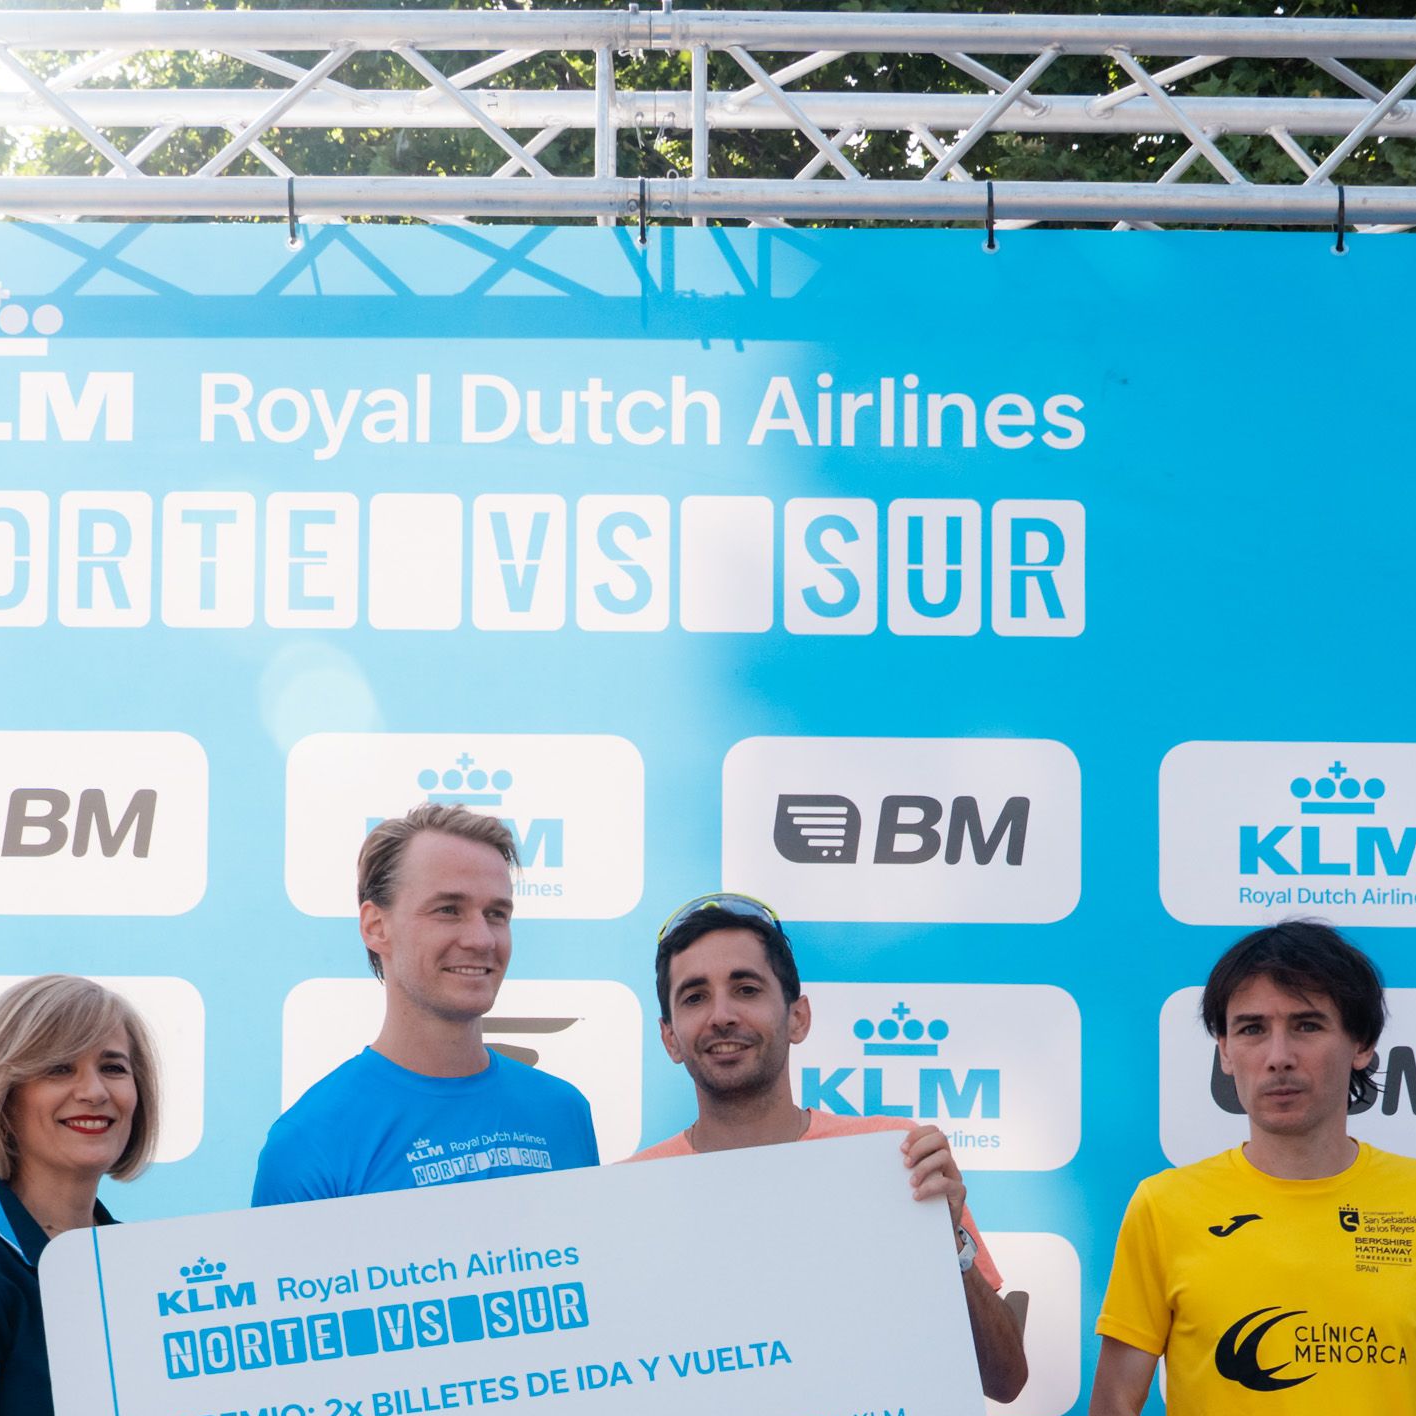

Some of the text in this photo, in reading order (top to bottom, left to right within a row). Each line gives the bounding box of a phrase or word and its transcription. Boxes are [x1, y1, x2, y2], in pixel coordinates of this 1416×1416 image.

[200, 371, 433, 460] Royal
[461, 374, 721, 447] Dutch
[748, 375, 1086, 451] Airlines
[489, 509, 656, 615] VS
[799, 512, 1066, 621] SUR
[2, 788, 157, 858] BM
[873, 795, 1030, 866] BM
[516, 880, 563, 897] lines
[1240, 888, 1291, 907] Royal
[1298, 888, 1356, 905] Dutch
[802, 1068, 1000, 1118] KLM
[406, 1144, 444, 1163] KLM
[450, 1137, 479, 1153] Royal
[512, 1131, 547, 1145] Airlines
[414, 1154, 478, 1185] NORTE
[520, 1149, 552, 1168] SUR
[1363, 1216, 1380, 1224] San
[1364, 1225, 1415, 1235] de los Reyes
[1354, 1237, 1412, 1247] BERKSHIRE
[1355, 1246, 1412, 1255] HATHAWAY
[157, 1246, 580, 1317] KLM Royal Dutch Airlines
[1355, 1264, 1379, 1273] SPAIN
[167, 1286, 586, 1376] NORTE VS SUR
[1295, 1322, 1378, 1343] CLÍNICA
[526, 1368, 569, 1398] DE
[577, 1361, 633, 1392] IDA
[638, 1356, 661, 1383] Y
[668, 1339, 792, 1378] VUELTA
[1295, 1345, 1407, 1365] MENORCA
